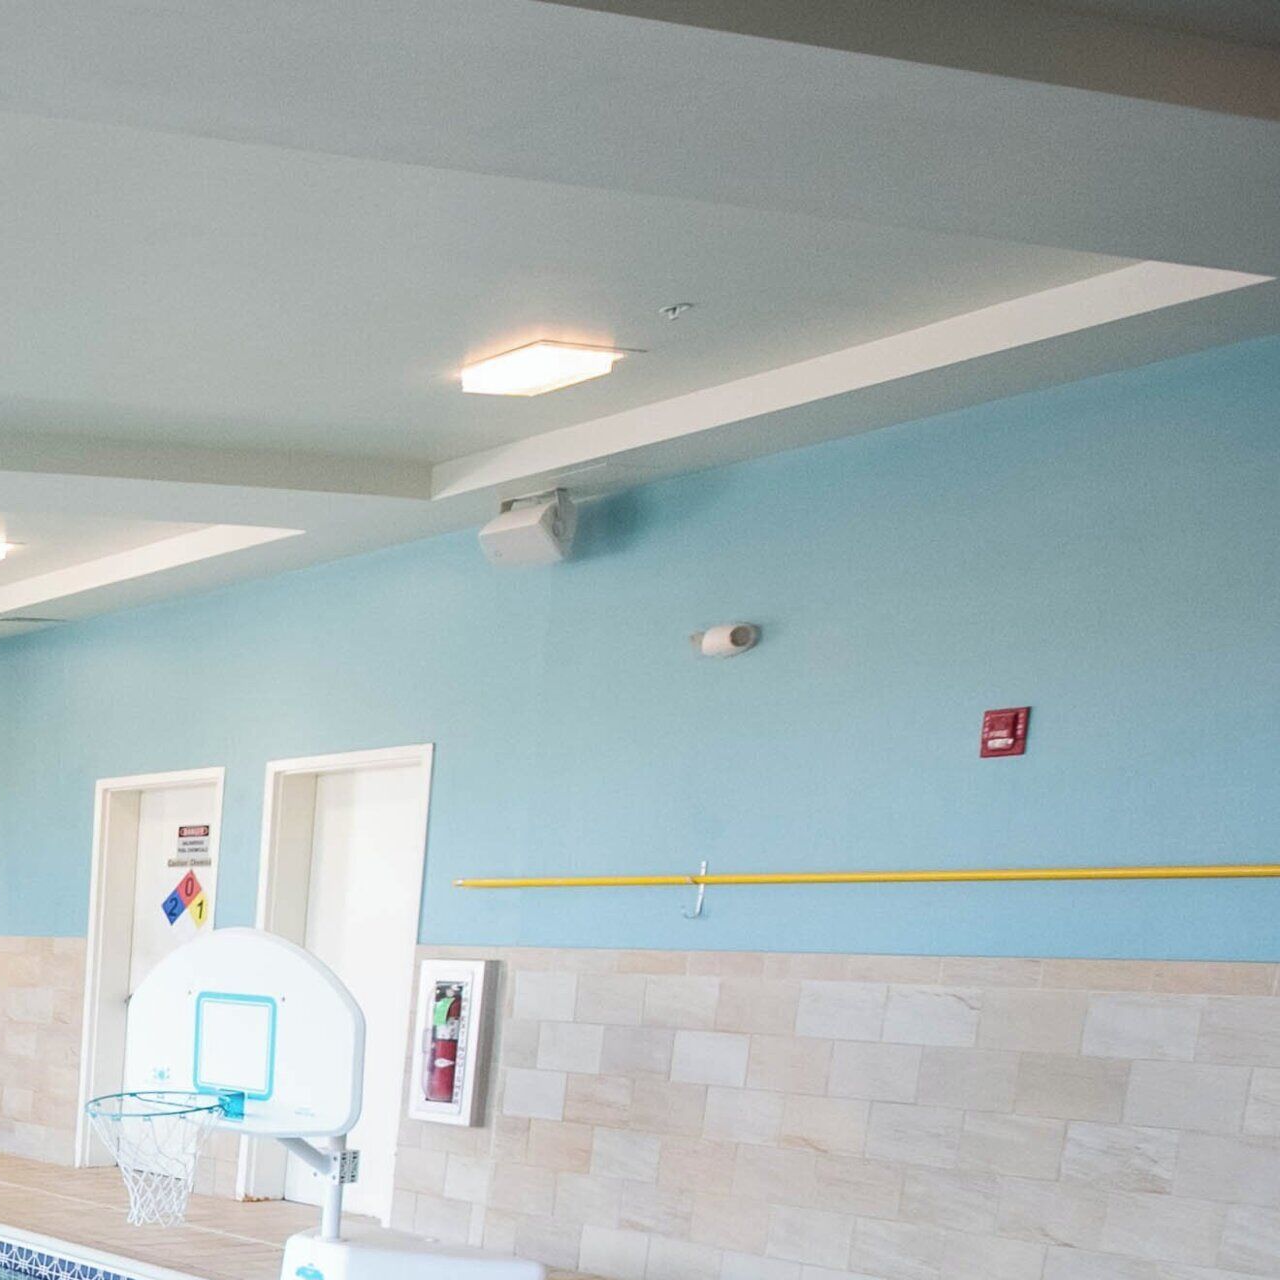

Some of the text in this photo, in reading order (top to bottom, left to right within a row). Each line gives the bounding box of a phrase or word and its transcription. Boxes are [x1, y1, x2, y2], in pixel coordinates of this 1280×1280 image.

[185, 877, 194, 897] 0
[168, 898, 204, 919] 2 1
